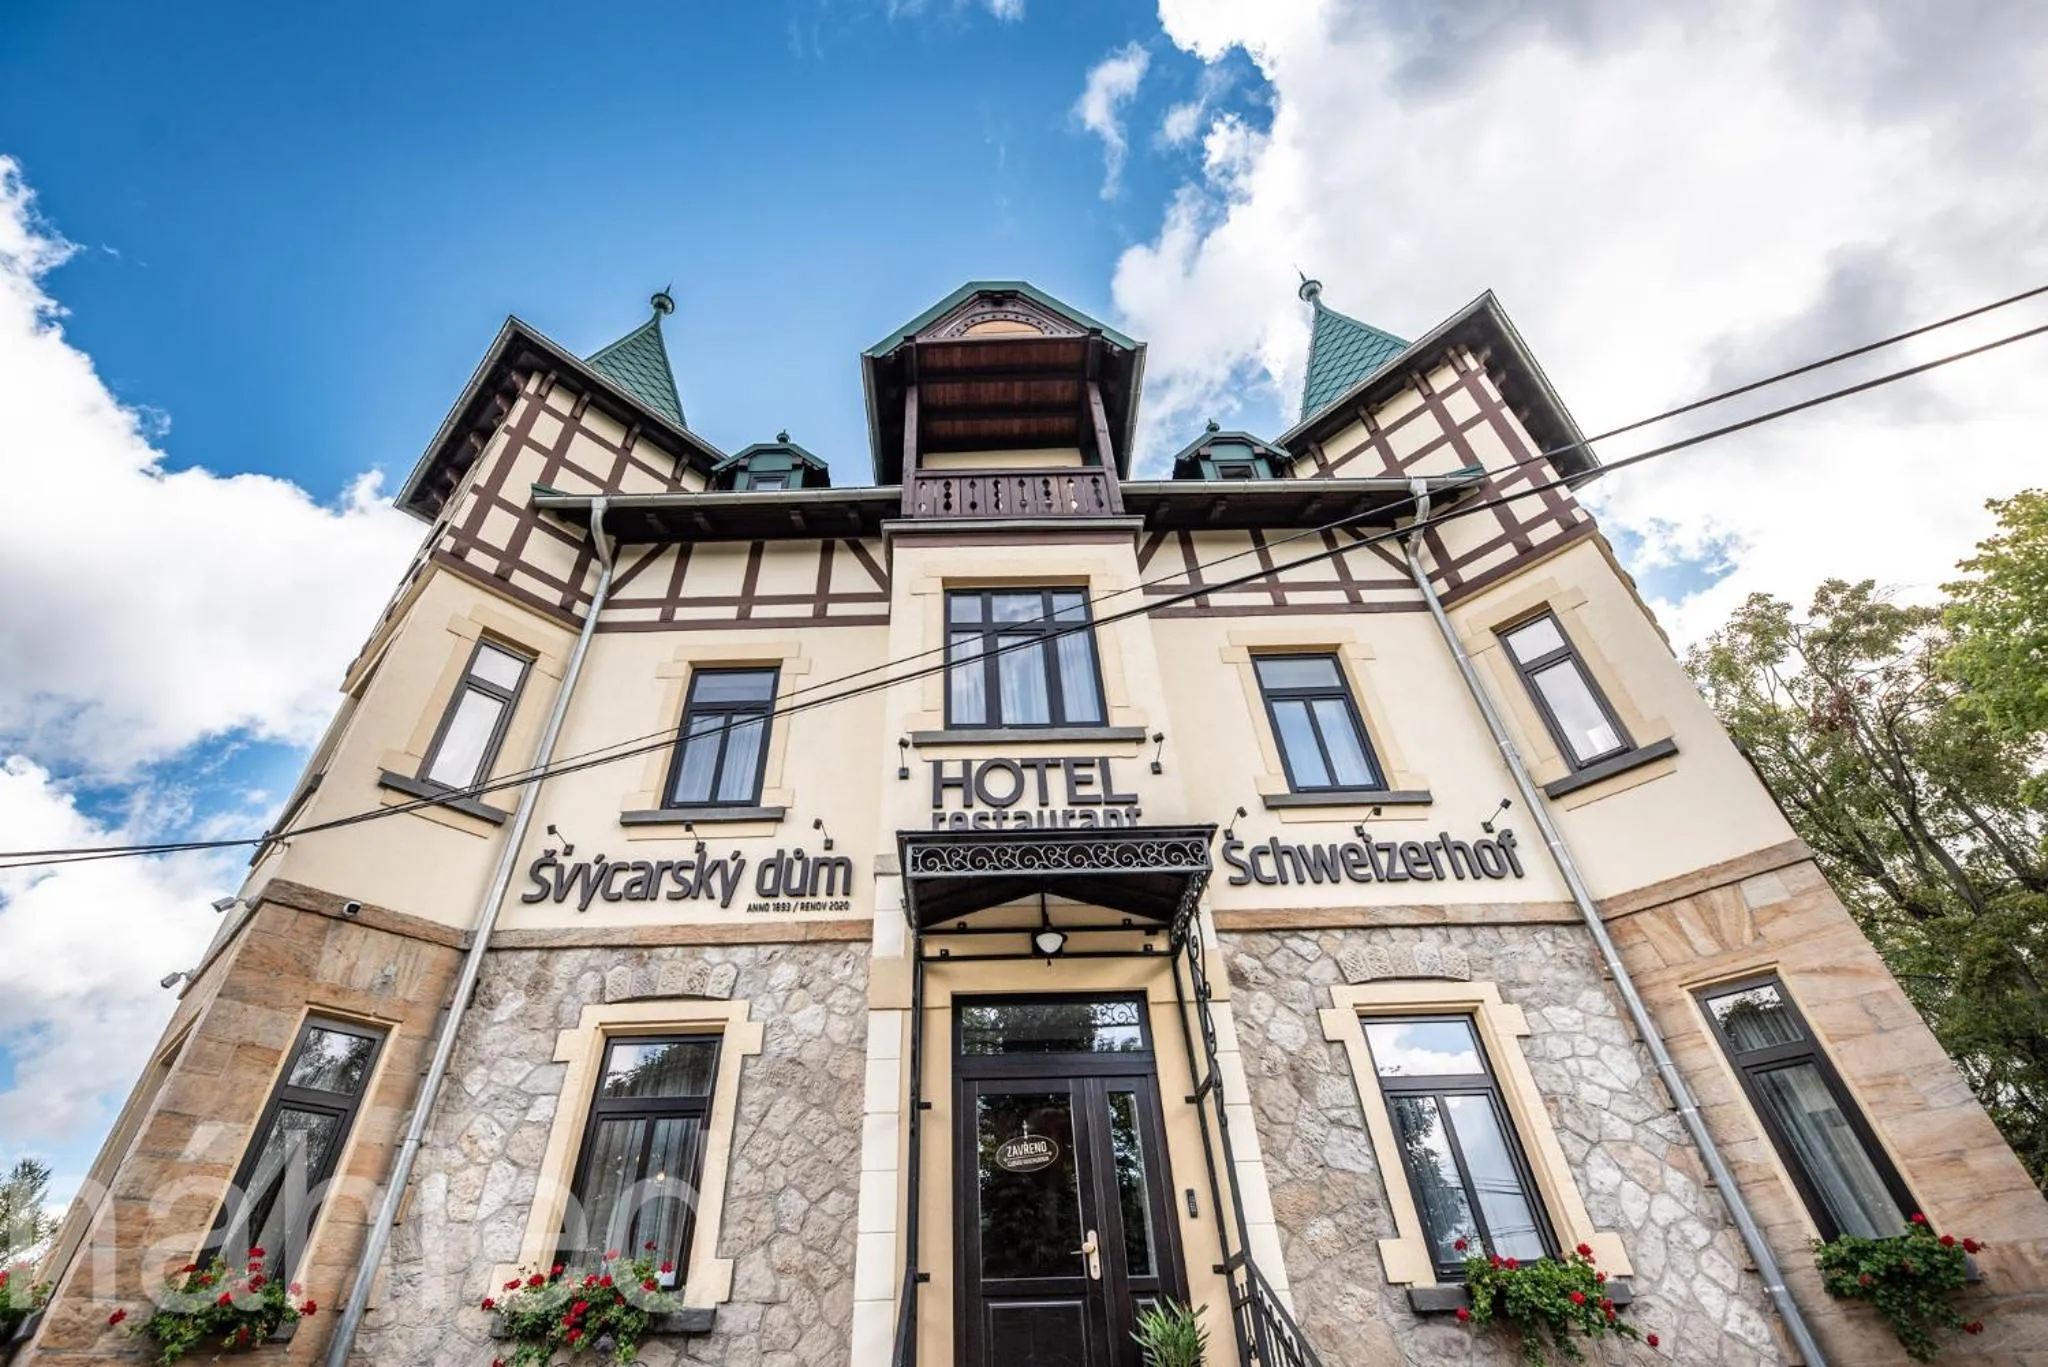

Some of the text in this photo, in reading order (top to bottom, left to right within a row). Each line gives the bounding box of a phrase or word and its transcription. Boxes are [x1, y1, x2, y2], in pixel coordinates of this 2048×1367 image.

[932, 757, 1138, 808] HOTEL
[520, 848, 852, 912] Švýcarský dům
[1223, 828, 1525, 886] Schweizerhof
[746, 902, 770, 913] ANNO
[800, 901, 828, 912] RENOV
[828, 901, 850, 911] 2020
